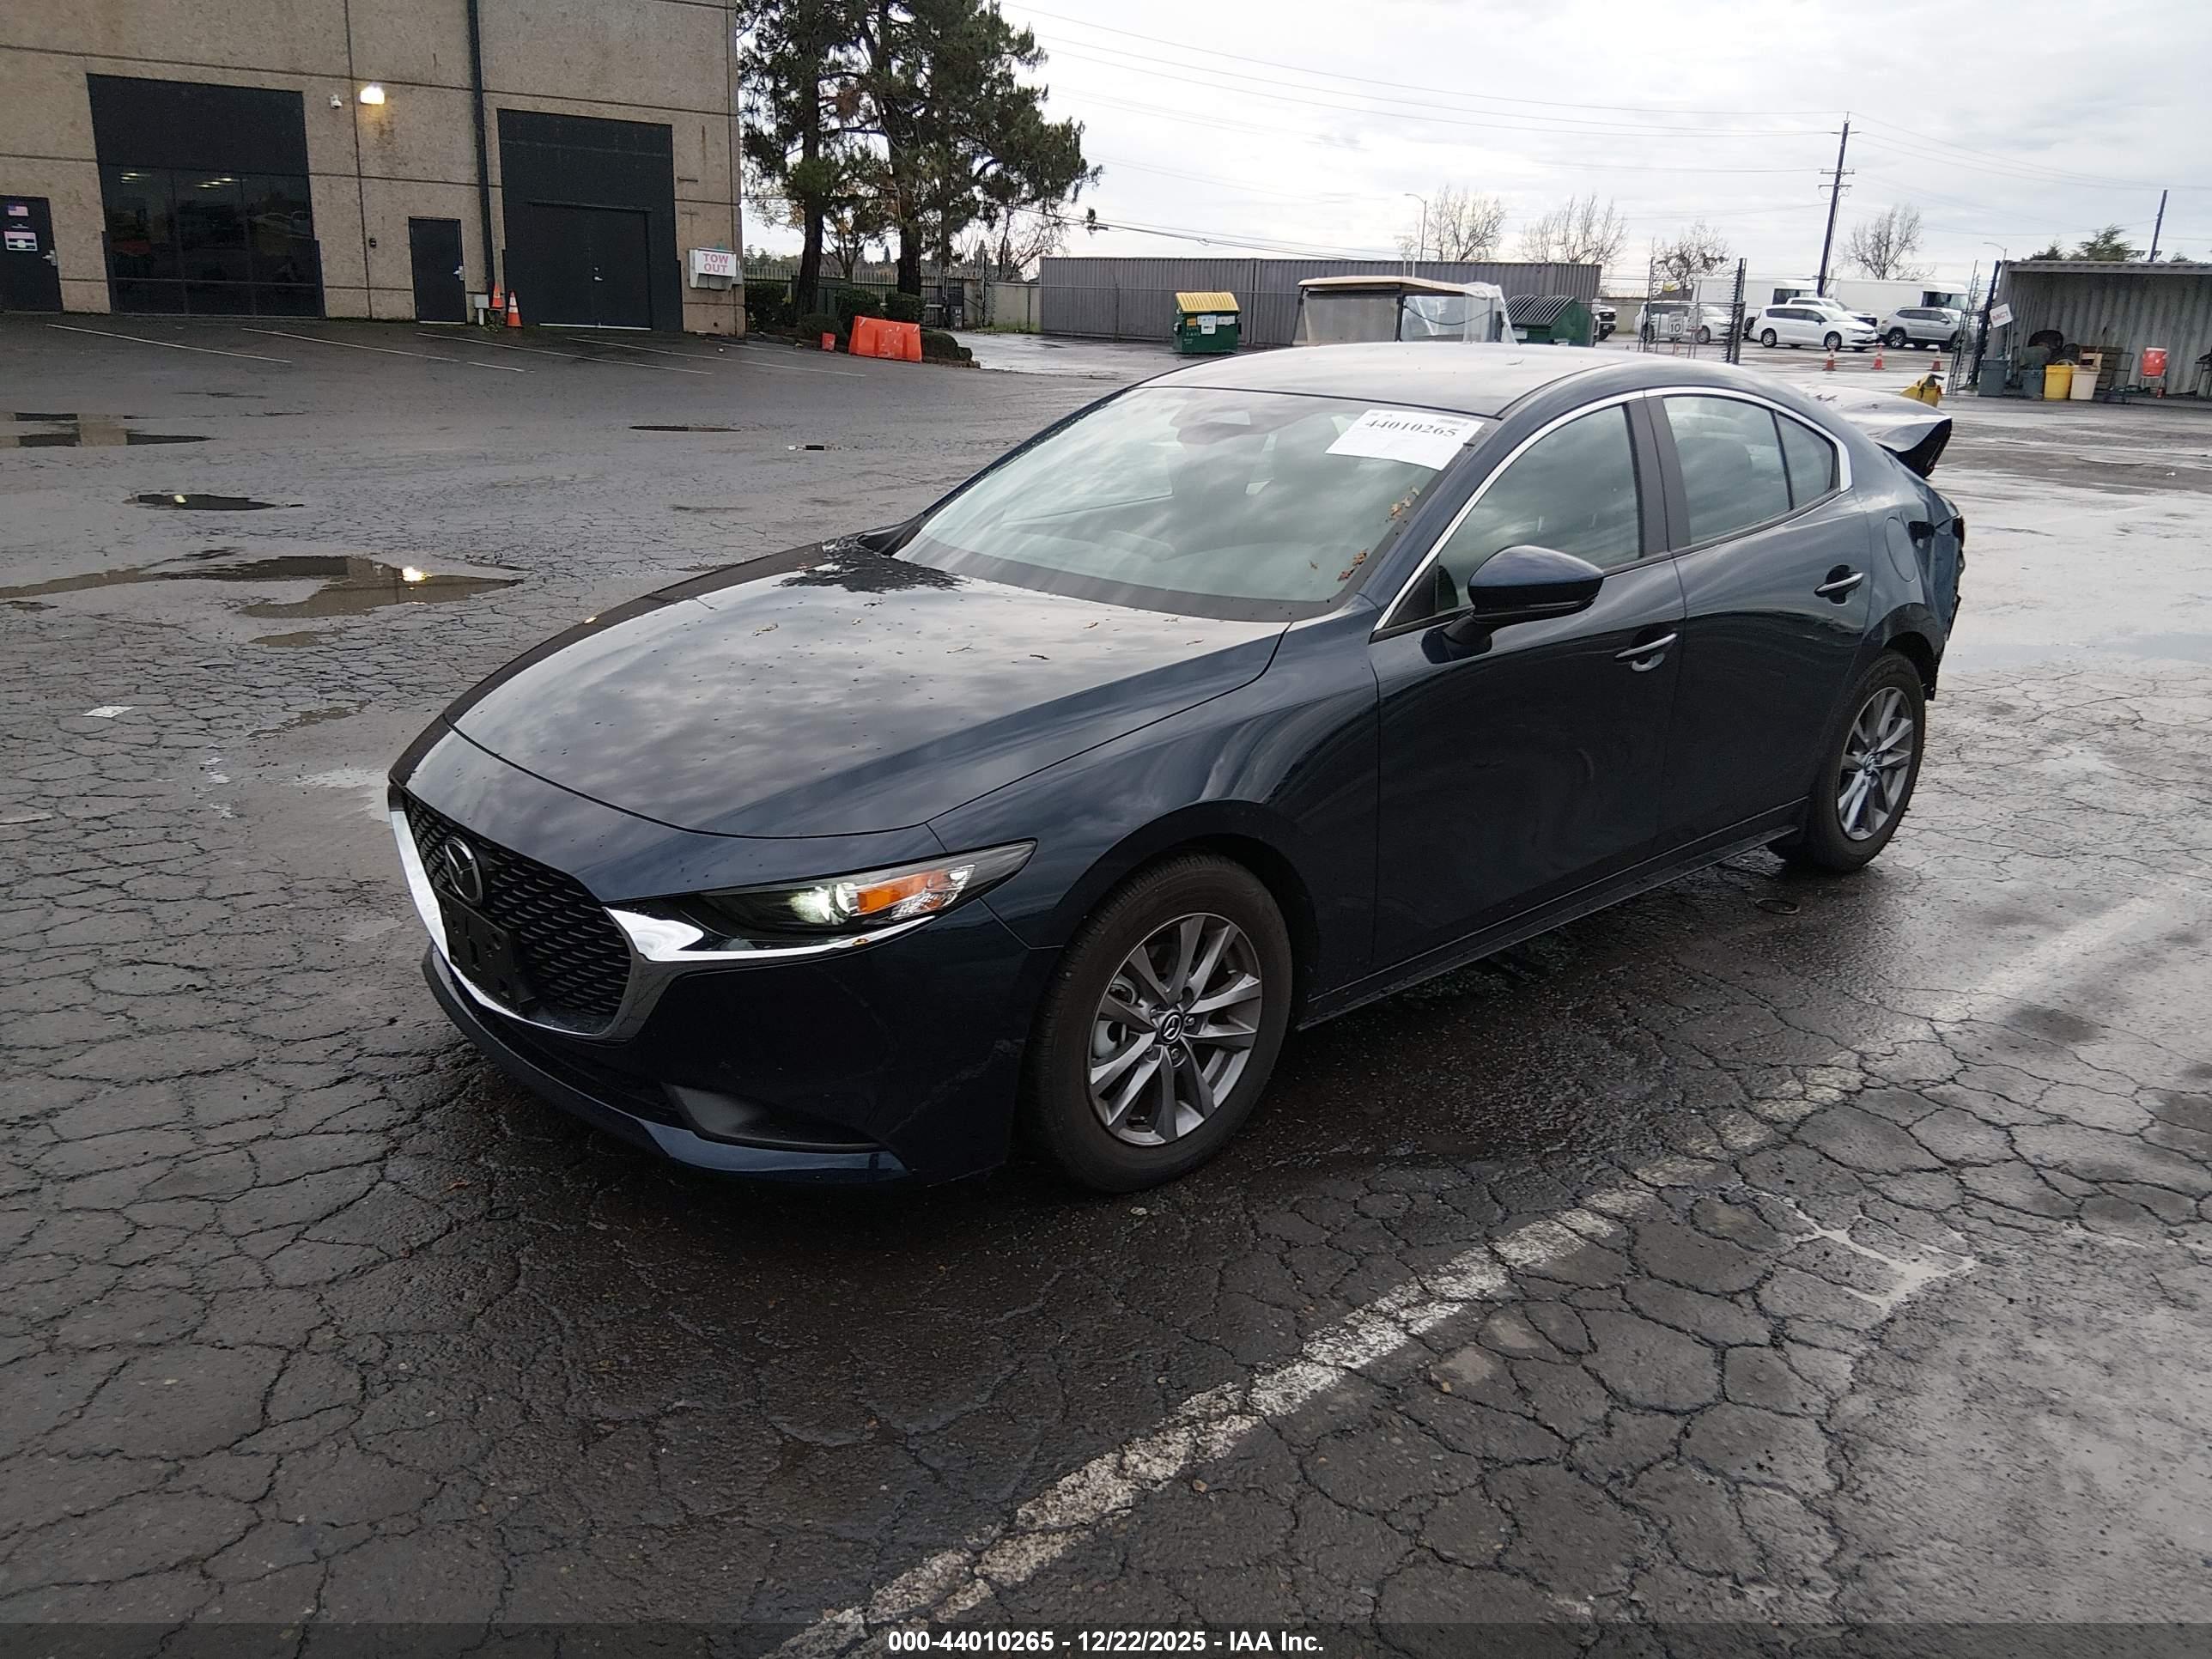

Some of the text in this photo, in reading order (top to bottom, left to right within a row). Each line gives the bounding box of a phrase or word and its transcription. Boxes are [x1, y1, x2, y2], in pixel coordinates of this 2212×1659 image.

[702, 253, 729, 264] TOW
[703, 263, 728, 274] OUT
[1670, 323, 1681, 332] 10
[1365, 419, 1460, 437] 44010265
